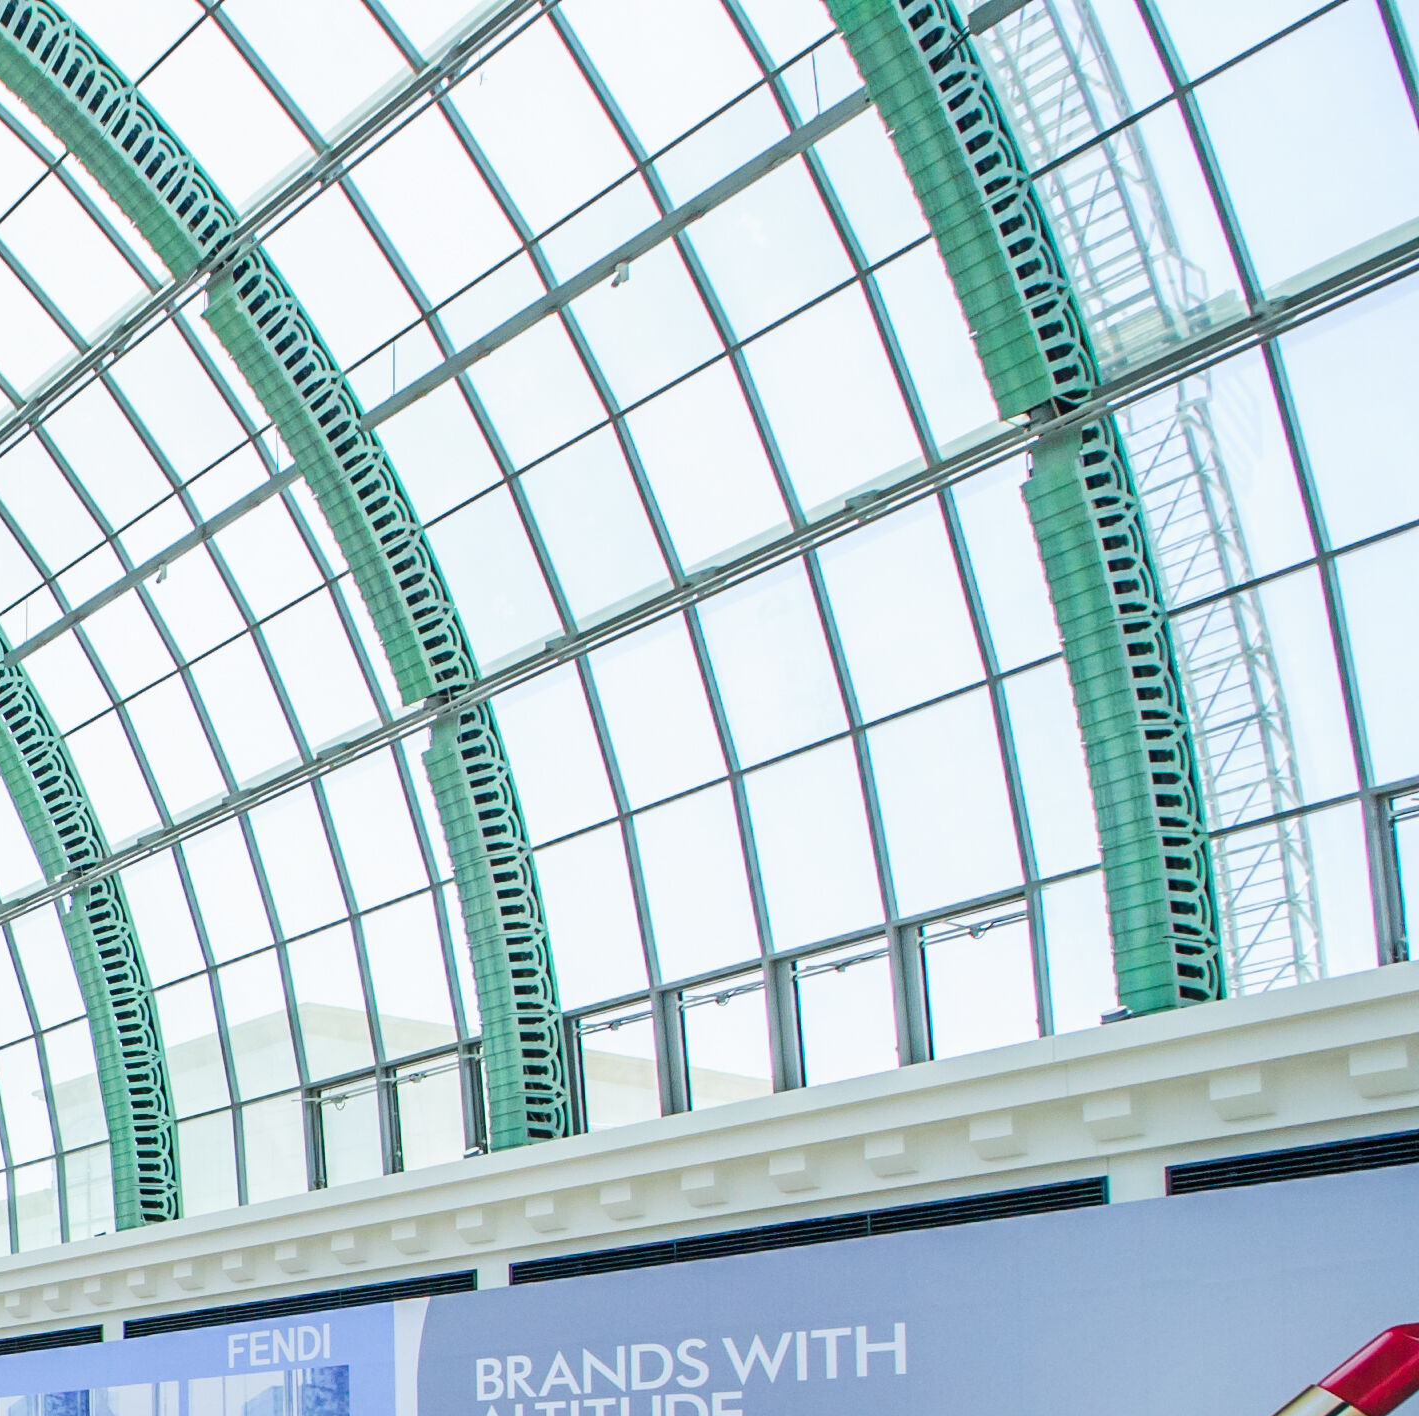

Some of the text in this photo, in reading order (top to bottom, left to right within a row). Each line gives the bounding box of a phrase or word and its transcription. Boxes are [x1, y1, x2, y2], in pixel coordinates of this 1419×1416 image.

[228, 1323, 331, 1369] FENDI
[475, 1322, 908, 1402] BRANDS WITH
